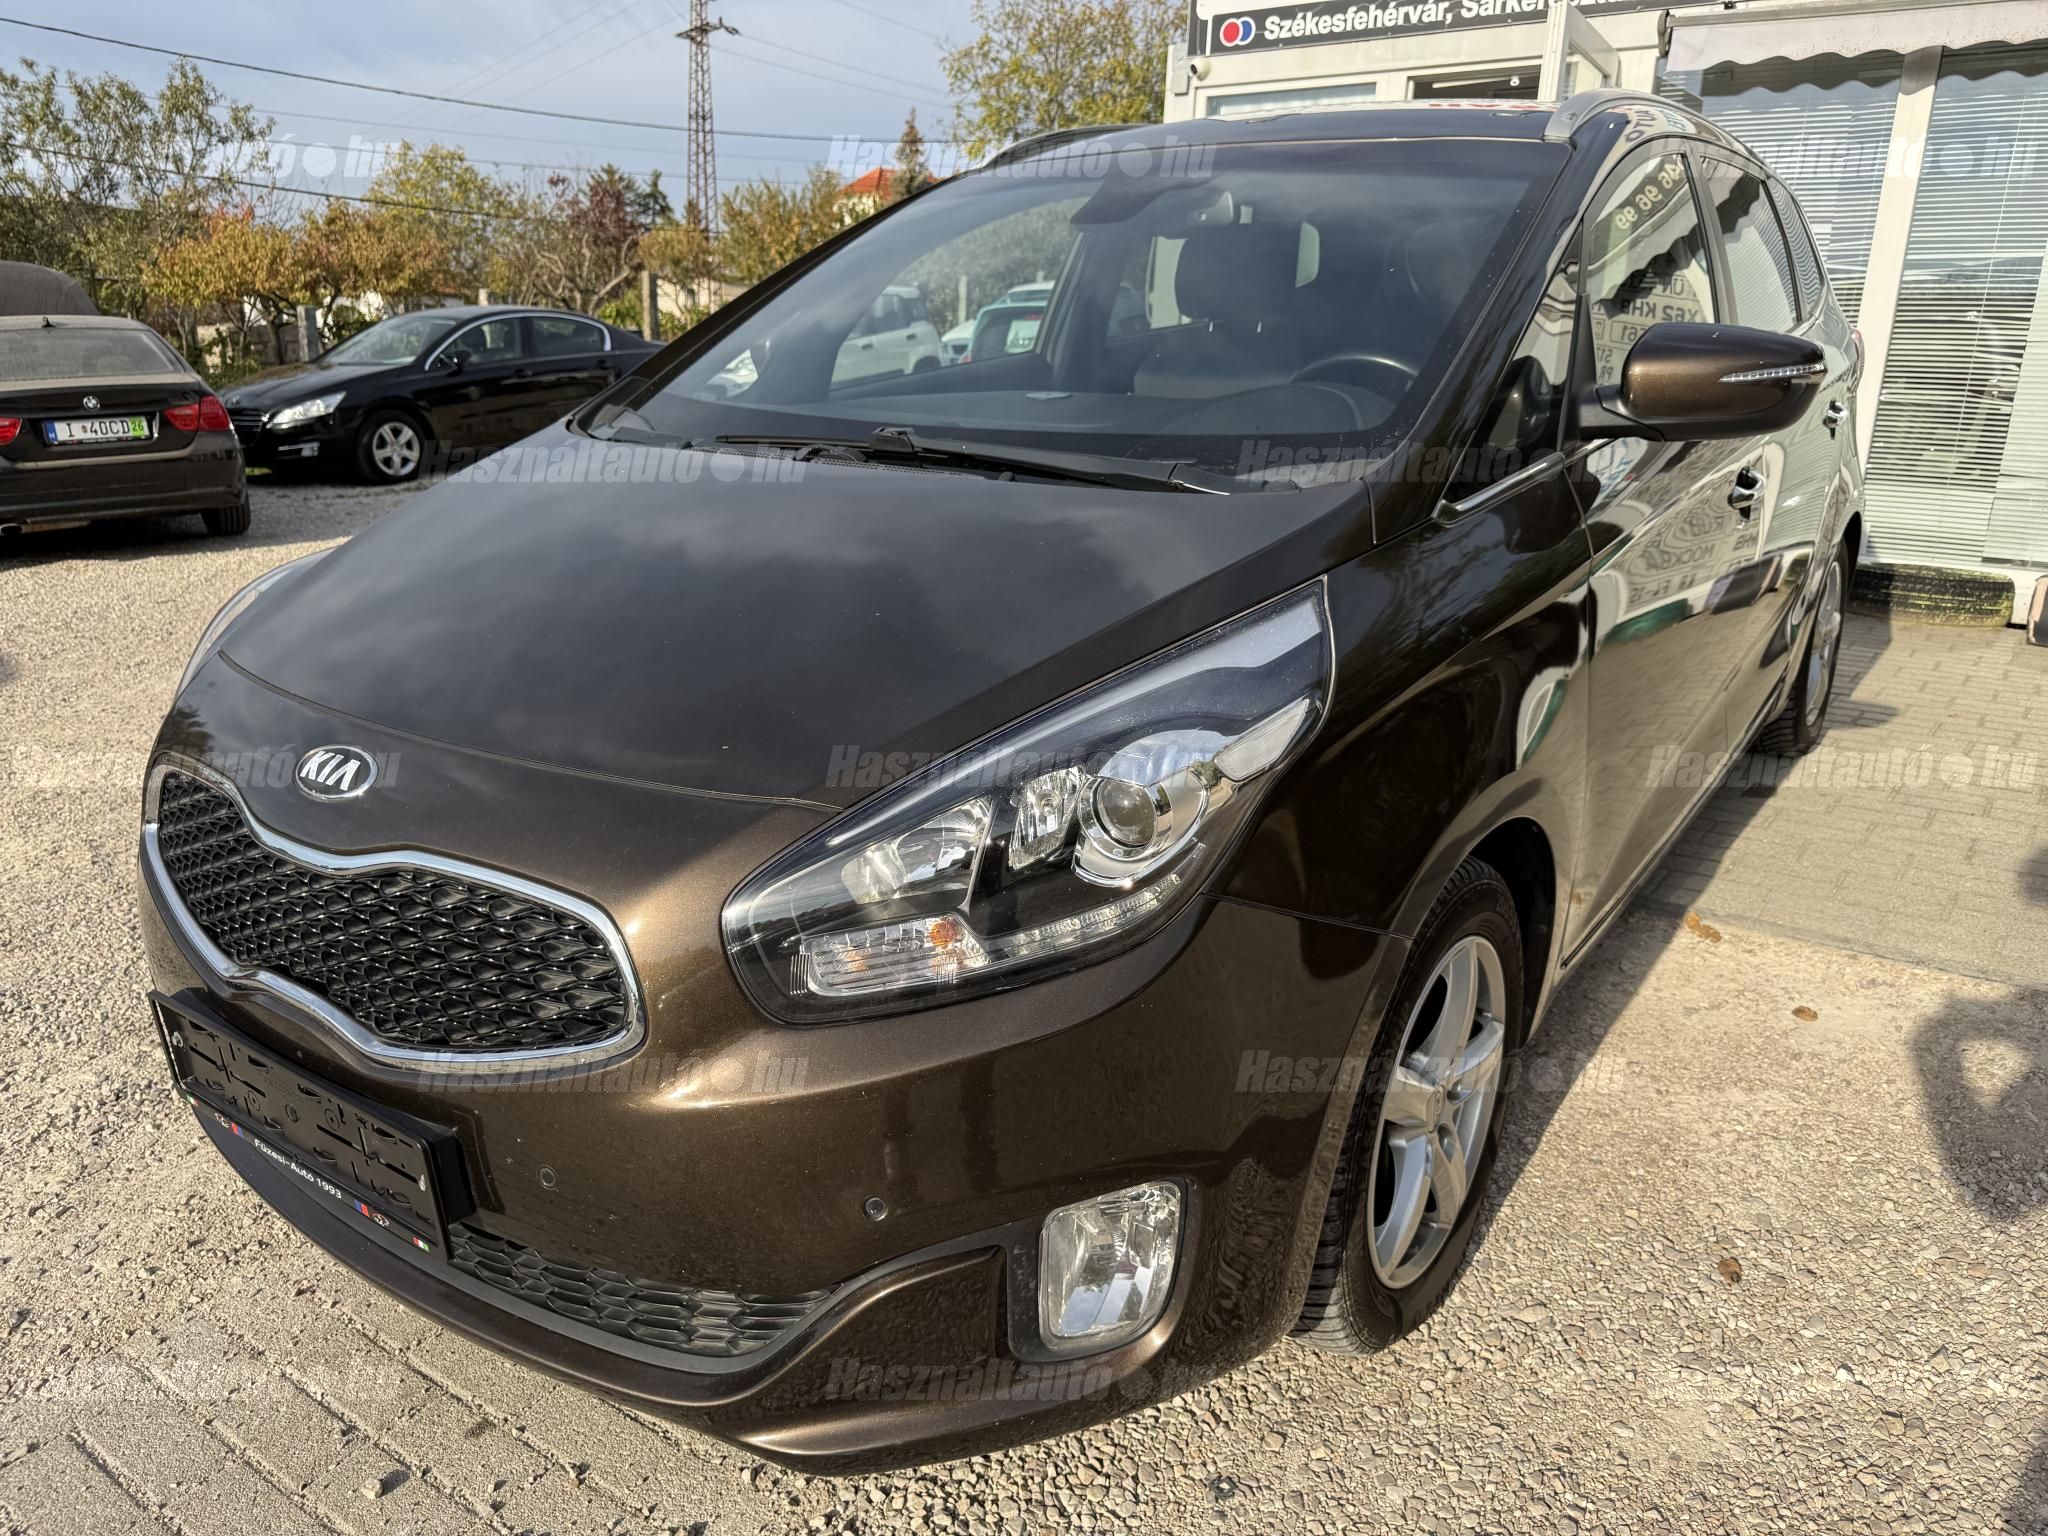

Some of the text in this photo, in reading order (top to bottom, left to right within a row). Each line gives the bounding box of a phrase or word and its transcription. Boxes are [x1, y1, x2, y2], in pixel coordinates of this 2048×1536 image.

[1264, 0, 1453, 40] Székesfehérvár,
[300, 751, 360, 791] KIA
[316, 1178, 342, 1199] 1993
